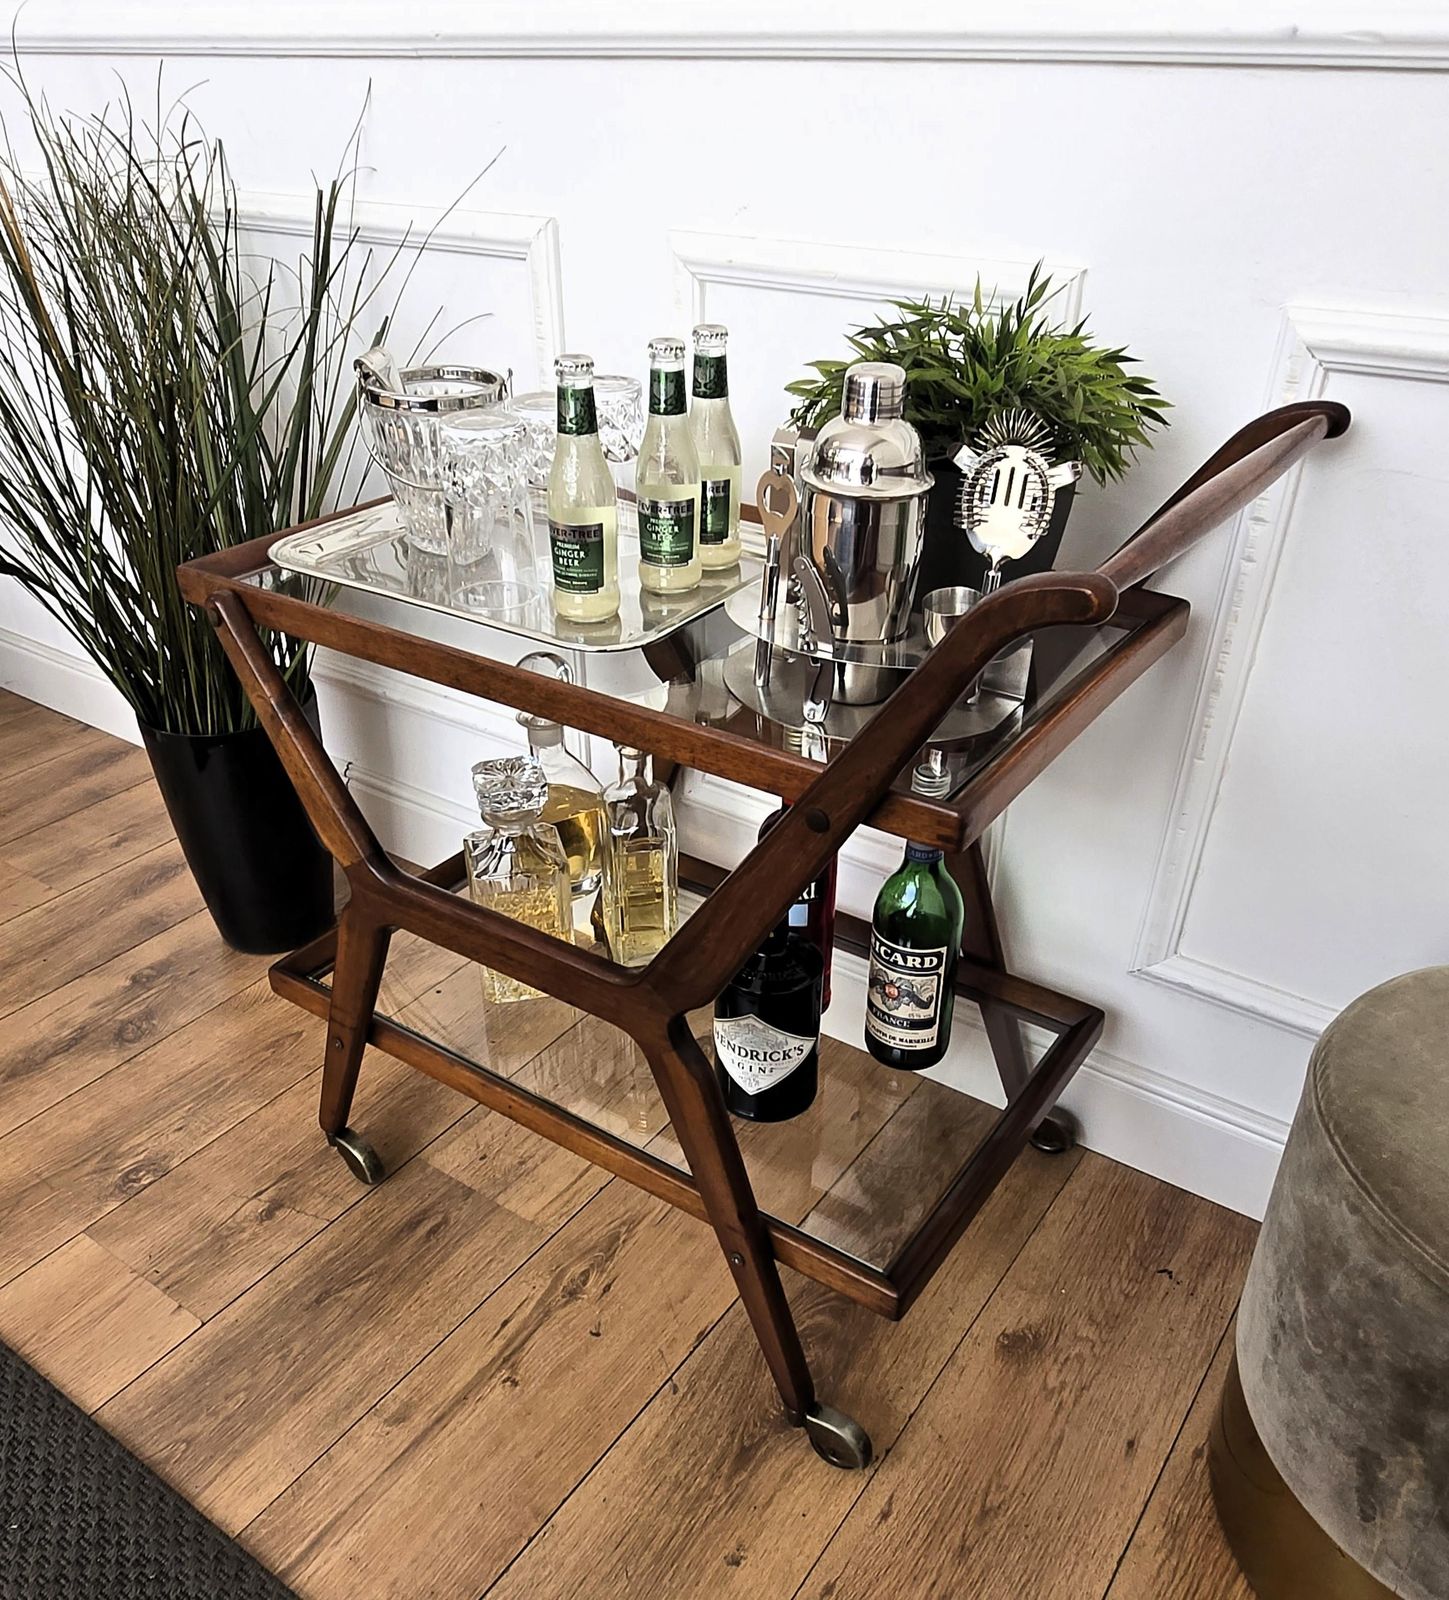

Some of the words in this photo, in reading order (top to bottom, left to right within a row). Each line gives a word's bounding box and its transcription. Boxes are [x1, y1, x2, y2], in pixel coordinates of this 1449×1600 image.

[554, 546, 586, 559] GINGER
[558, 557, 580, 567] BEER
[872, 1007, 911, 1028] FRANCE
[737, 1061, 767, 1074] GIN
